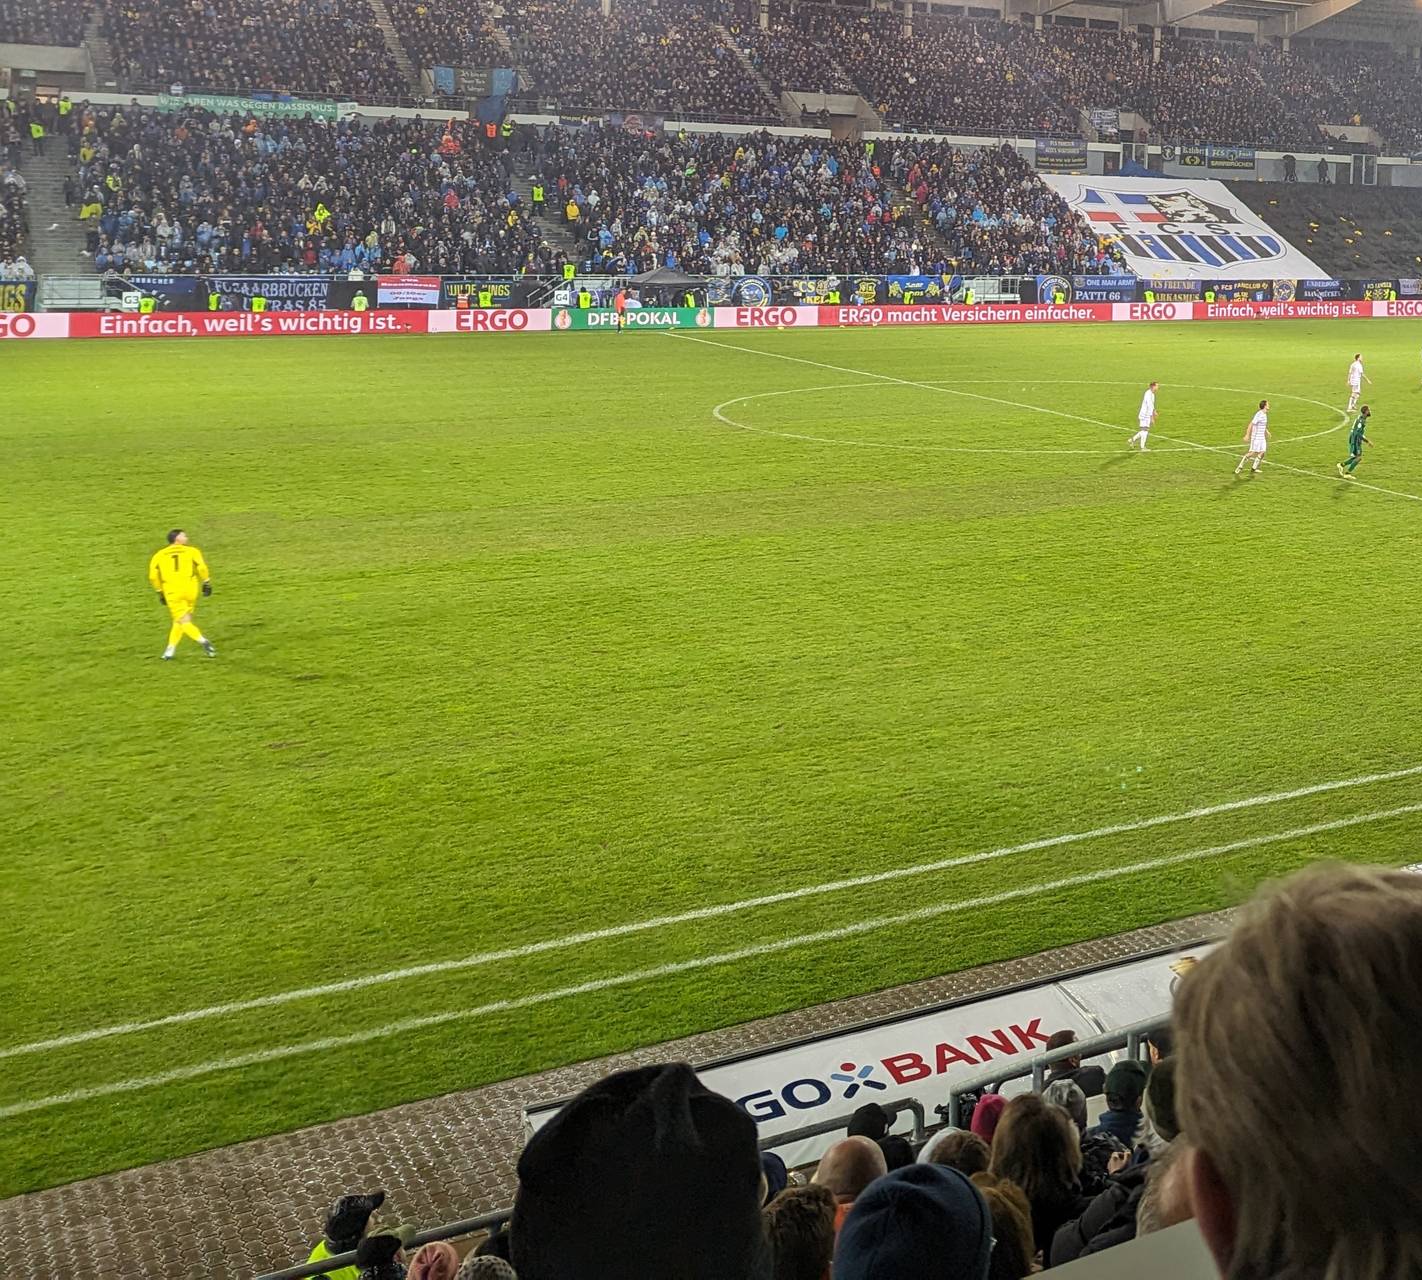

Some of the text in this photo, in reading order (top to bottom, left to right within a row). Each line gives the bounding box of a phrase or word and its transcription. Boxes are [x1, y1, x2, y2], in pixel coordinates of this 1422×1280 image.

[241, 101, 275, 110] GEGEN
[1075, 290, 1120, 300] PATTI 66
[736, 308, 797, 326] ERGO
[838, 306, 1096, 323] ERGO macht Versichern einfacher.
[1129, 303, 1176, 320] ERGO
[1207, 302, 1360, 319] Einfach, weil's wichtig ist.
[100, 310, 401, 336] Einfach, weil's wichtig ist.
[456, 309, 528, 330] ERGO
[626, 313, 681, 326] POKAL
[170, 554, 179, 572] 1
[880, 1018, 1052, 1085] BANK
